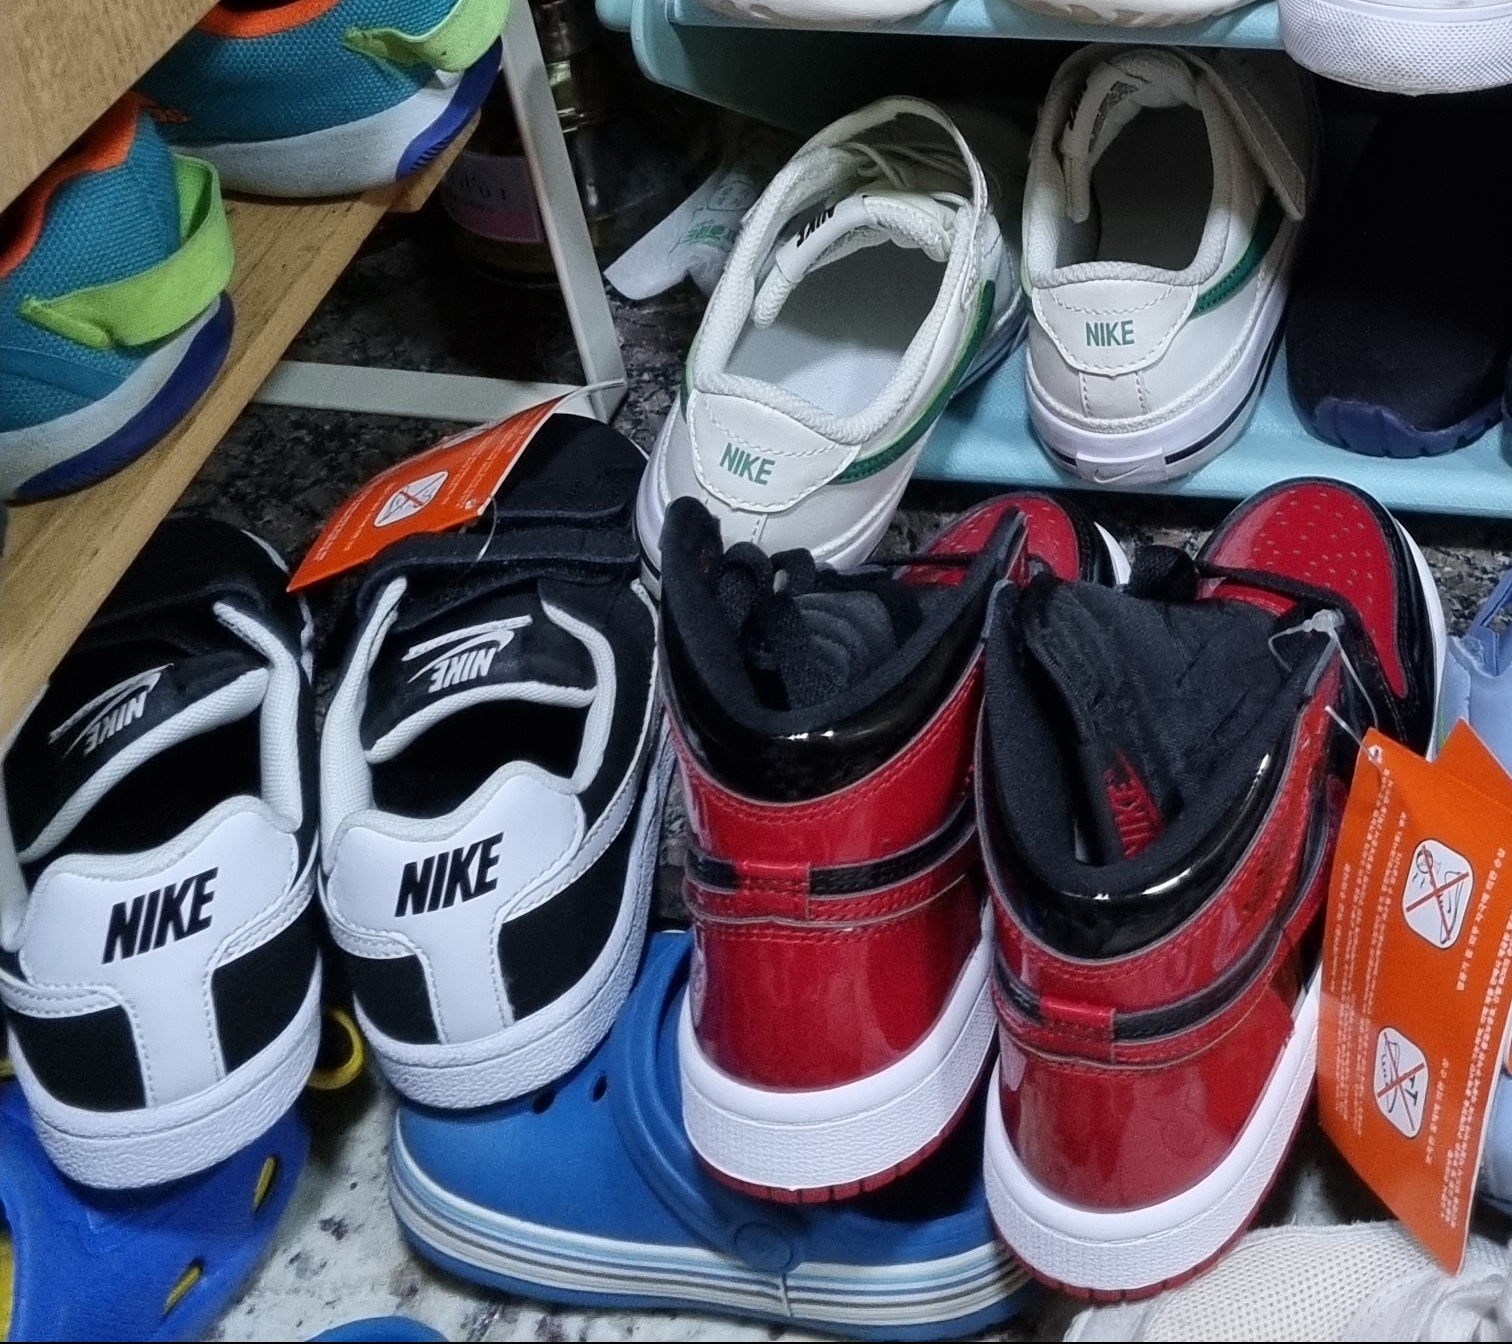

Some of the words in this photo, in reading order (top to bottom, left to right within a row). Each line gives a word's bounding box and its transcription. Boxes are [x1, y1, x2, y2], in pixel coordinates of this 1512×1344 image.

[1085, 319, 1135, 347] NIKE
[719, 441, 776, 486] NIKE
[428, 647, 498, 693] NIKE
[82, 691, 148, 757] NIKE
[395, 831, 504, 918] NIKE
[102, 866, 218, 965] NIKE
